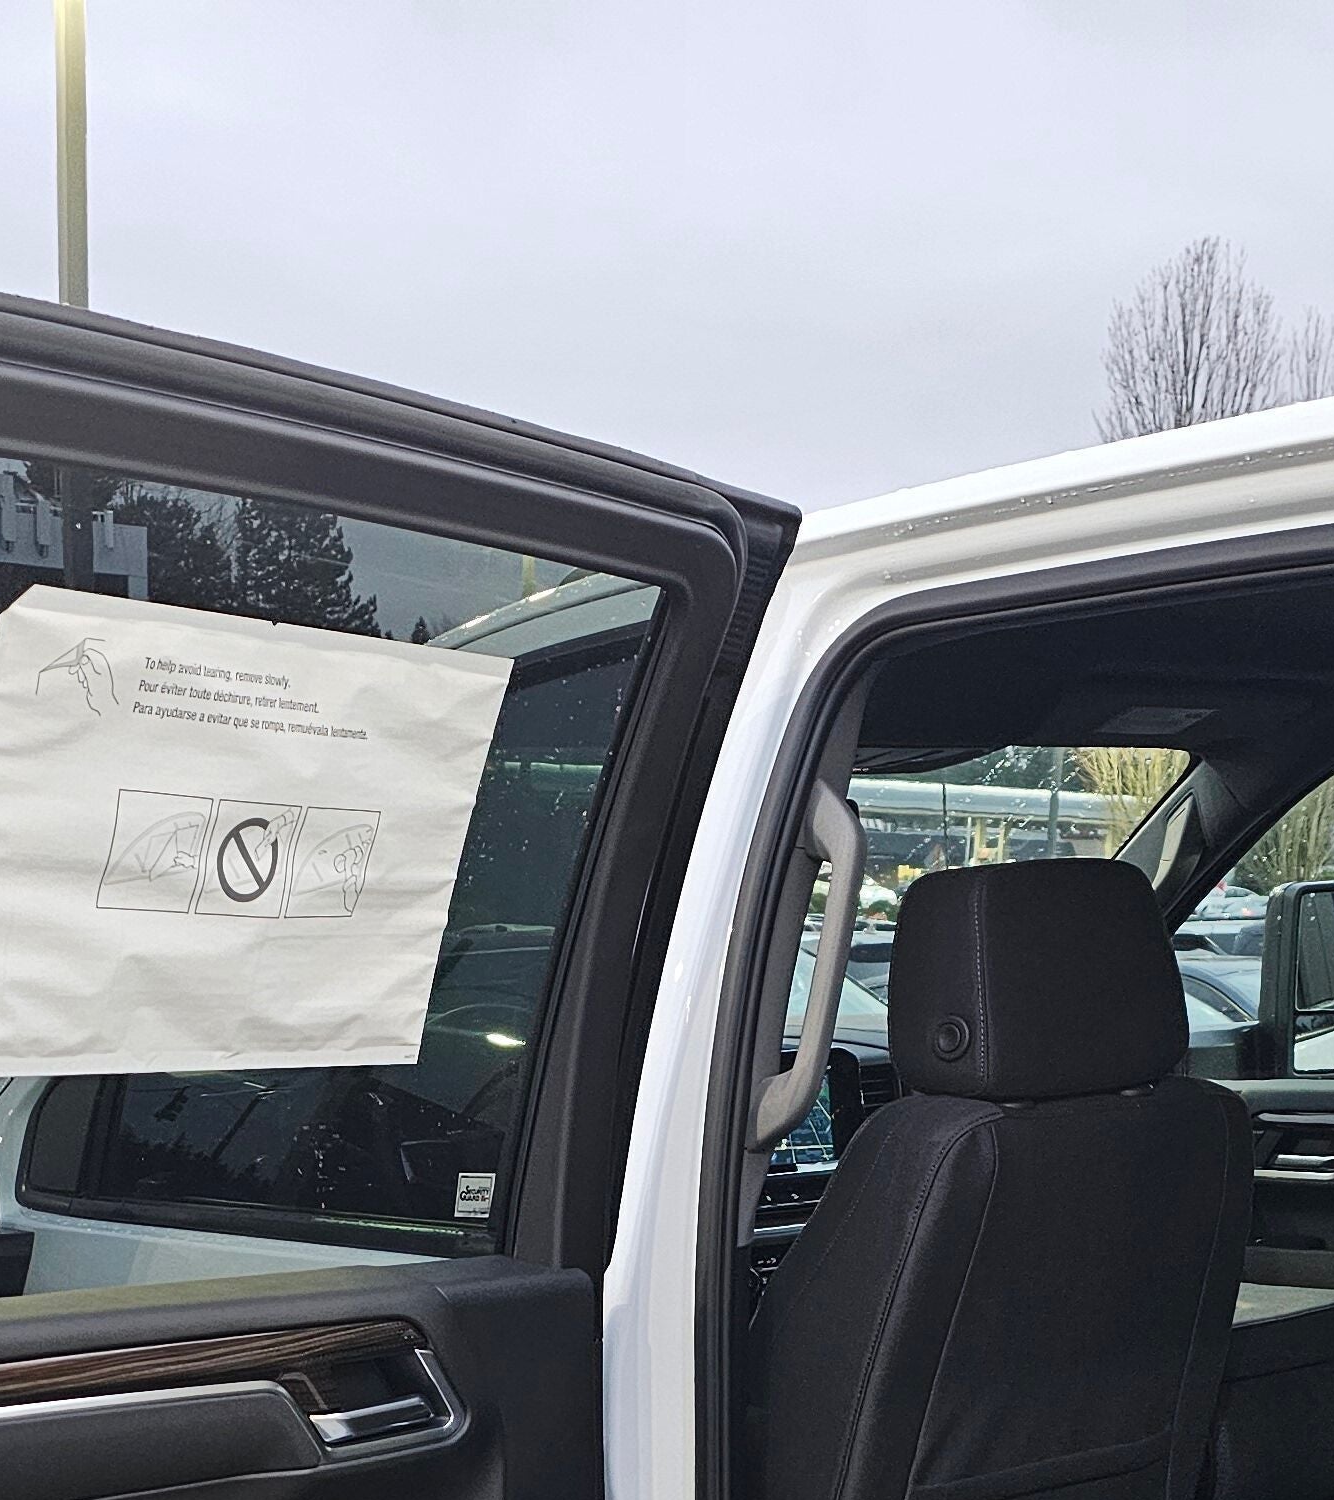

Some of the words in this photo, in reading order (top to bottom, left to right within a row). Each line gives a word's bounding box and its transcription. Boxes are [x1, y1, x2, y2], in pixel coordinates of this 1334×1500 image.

[145, 657, 156, 670] To
[156, 659, 176, 674] help
[178, 663, 202, 677] avoid
[235, 672, 263, 684] remove
[264, 674, 291, 689] slowly.
[139, 680, 159, 692] Pour
[161, 682, 187, 696] éviter
[189, 686, 211, 700] toute
[213, 689, 253, 708] déchirure,
[255, 695, 277, 709] retirer
[133, 702, 153, 714] Para
[155, 705, 197, 721] ayudarse
[199, 712, 205, 722] a
[207, 711, 232, 726] evitar
[233, 717, 248, 729] que
[250, 720, 260, 729] se
